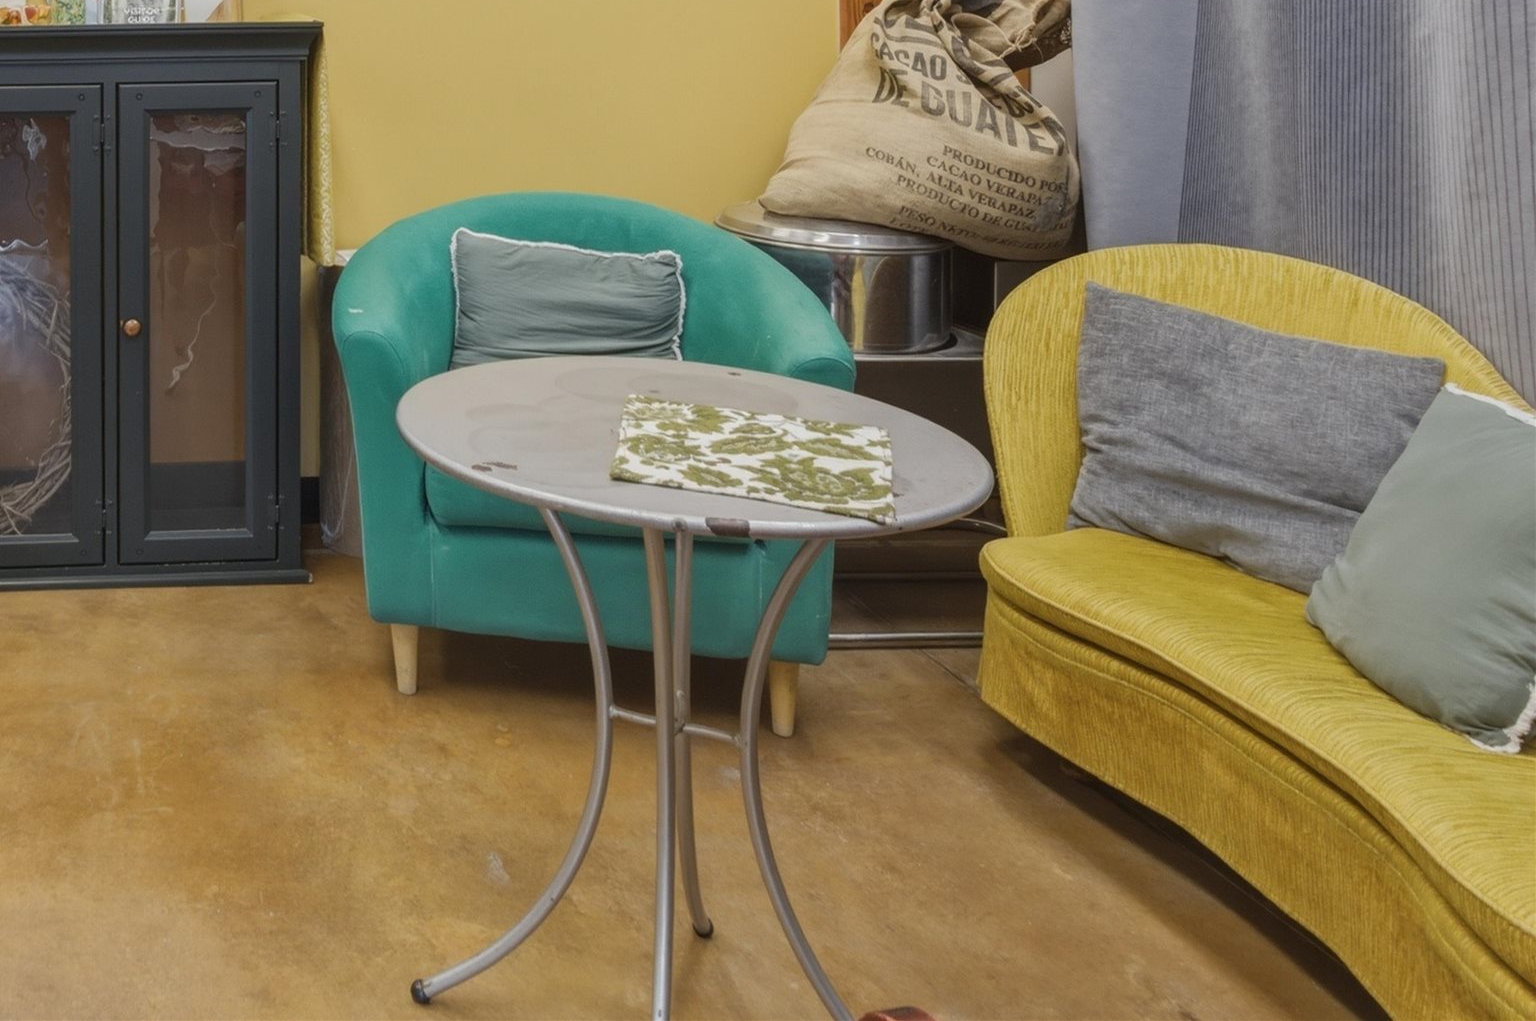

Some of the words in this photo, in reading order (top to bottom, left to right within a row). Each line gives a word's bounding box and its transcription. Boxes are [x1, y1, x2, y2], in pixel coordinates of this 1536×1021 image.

[926, 155, 982, 186] CACAO
[943, 144, 1036, 188] PRODUCIDO
[896, 174, 980, 219] PRODUCTO
[982, 213, 1002, 226] DE
[926, 172, 964, 197] ALTA
[898, 205, 937, 227] PESO
